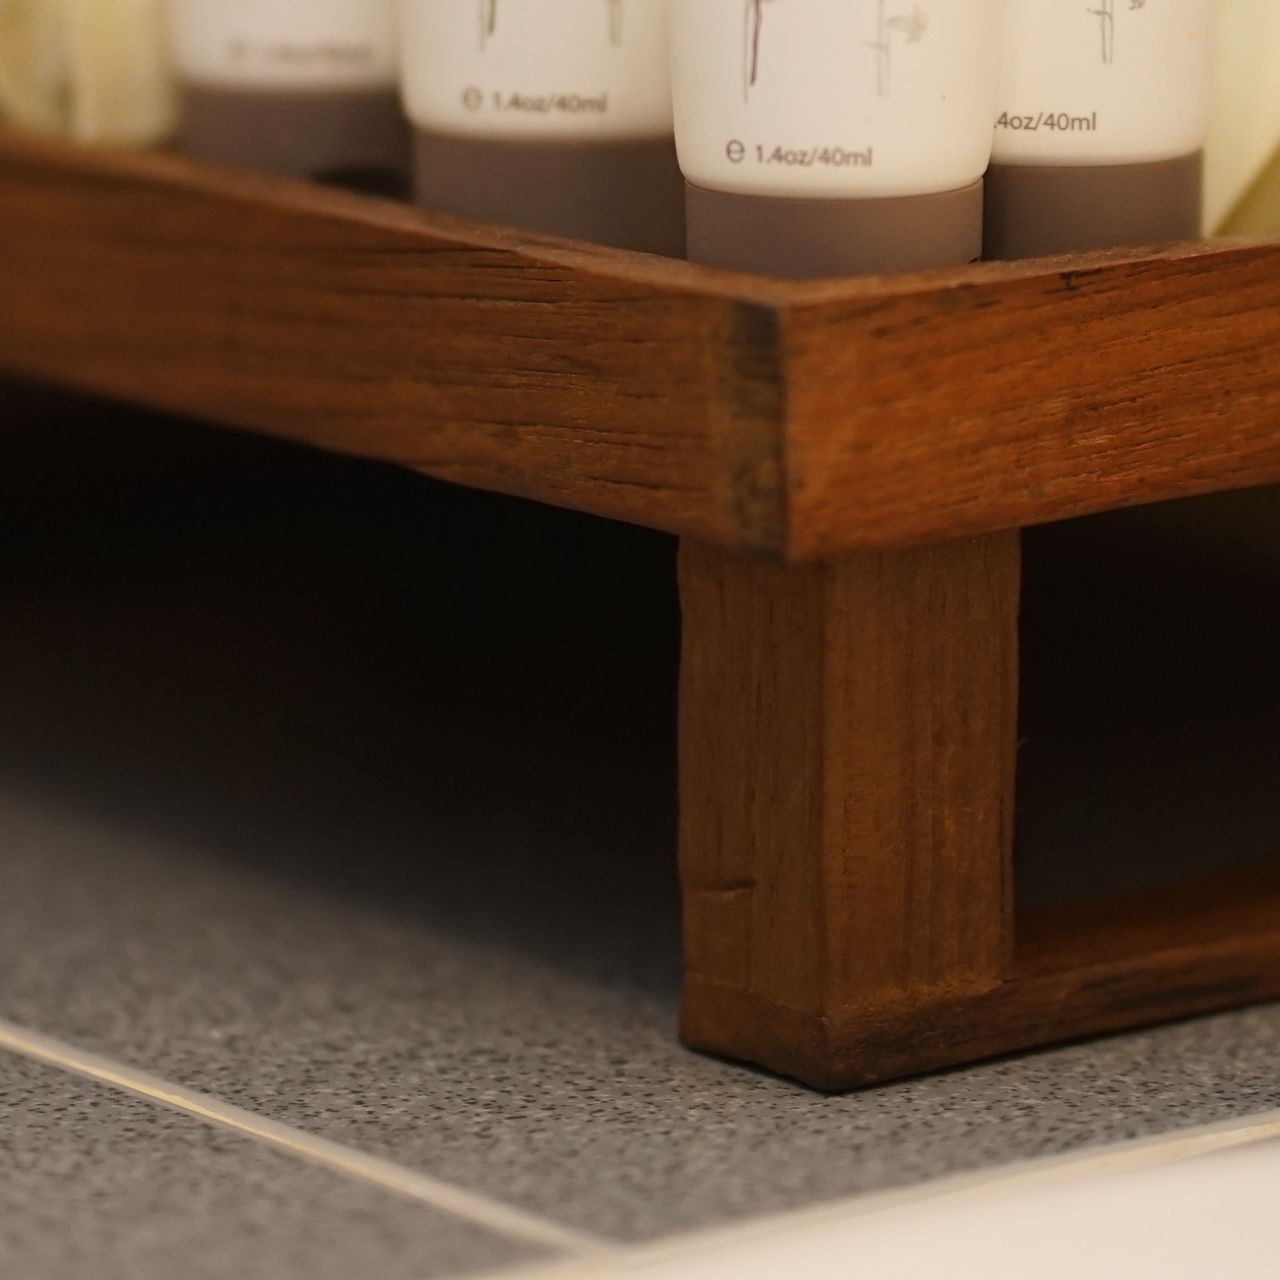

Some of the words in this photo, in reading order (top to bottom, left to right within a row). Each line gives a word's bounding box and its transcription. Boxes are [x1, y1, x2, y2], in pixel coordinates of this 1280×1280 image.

[493, 91, 608, 113] 1.4oz/40ml
[993, 111, 1097, 131] .4oz/40ml
[756, 143, 873, 167] 1.4oz/40ml
